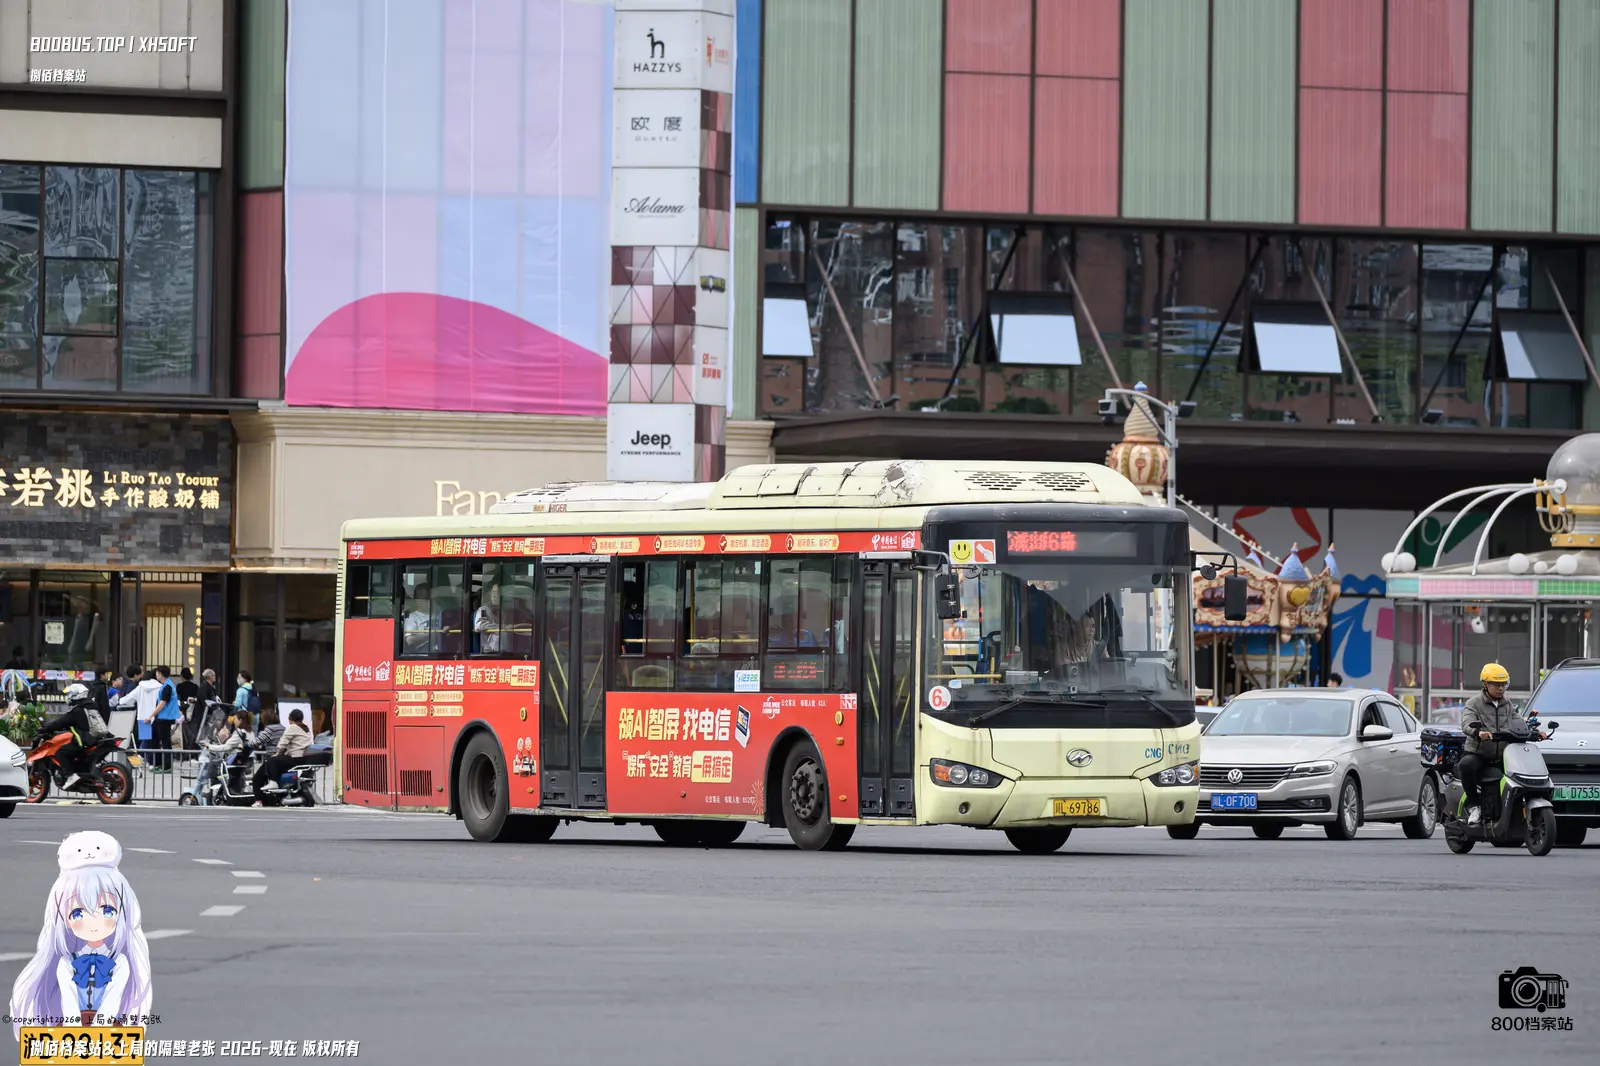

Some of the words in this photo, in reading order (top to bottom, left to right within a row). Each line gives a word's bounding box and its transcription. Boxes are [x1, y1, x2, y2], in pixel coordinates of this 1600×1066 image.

[633, 63, 682, 73] HAZZYS
[631, 116, 682, 132] 欧度
[624, 196, 685, 214] Aolama
[631, 430, 671, 450] Jeep
[100, 486, 220, 510] 手作酸奶铺
[395, 664, 434, 686] 领AI智屏
[434, 664, 465, 686] 找电信
[618, 707, 680, 741] 领AI智屏
[682, 707, 731, 741] 找电信
[1145, 747, 1162, 759] CNG
[693, 755, 732, 779] 一屏搞定
